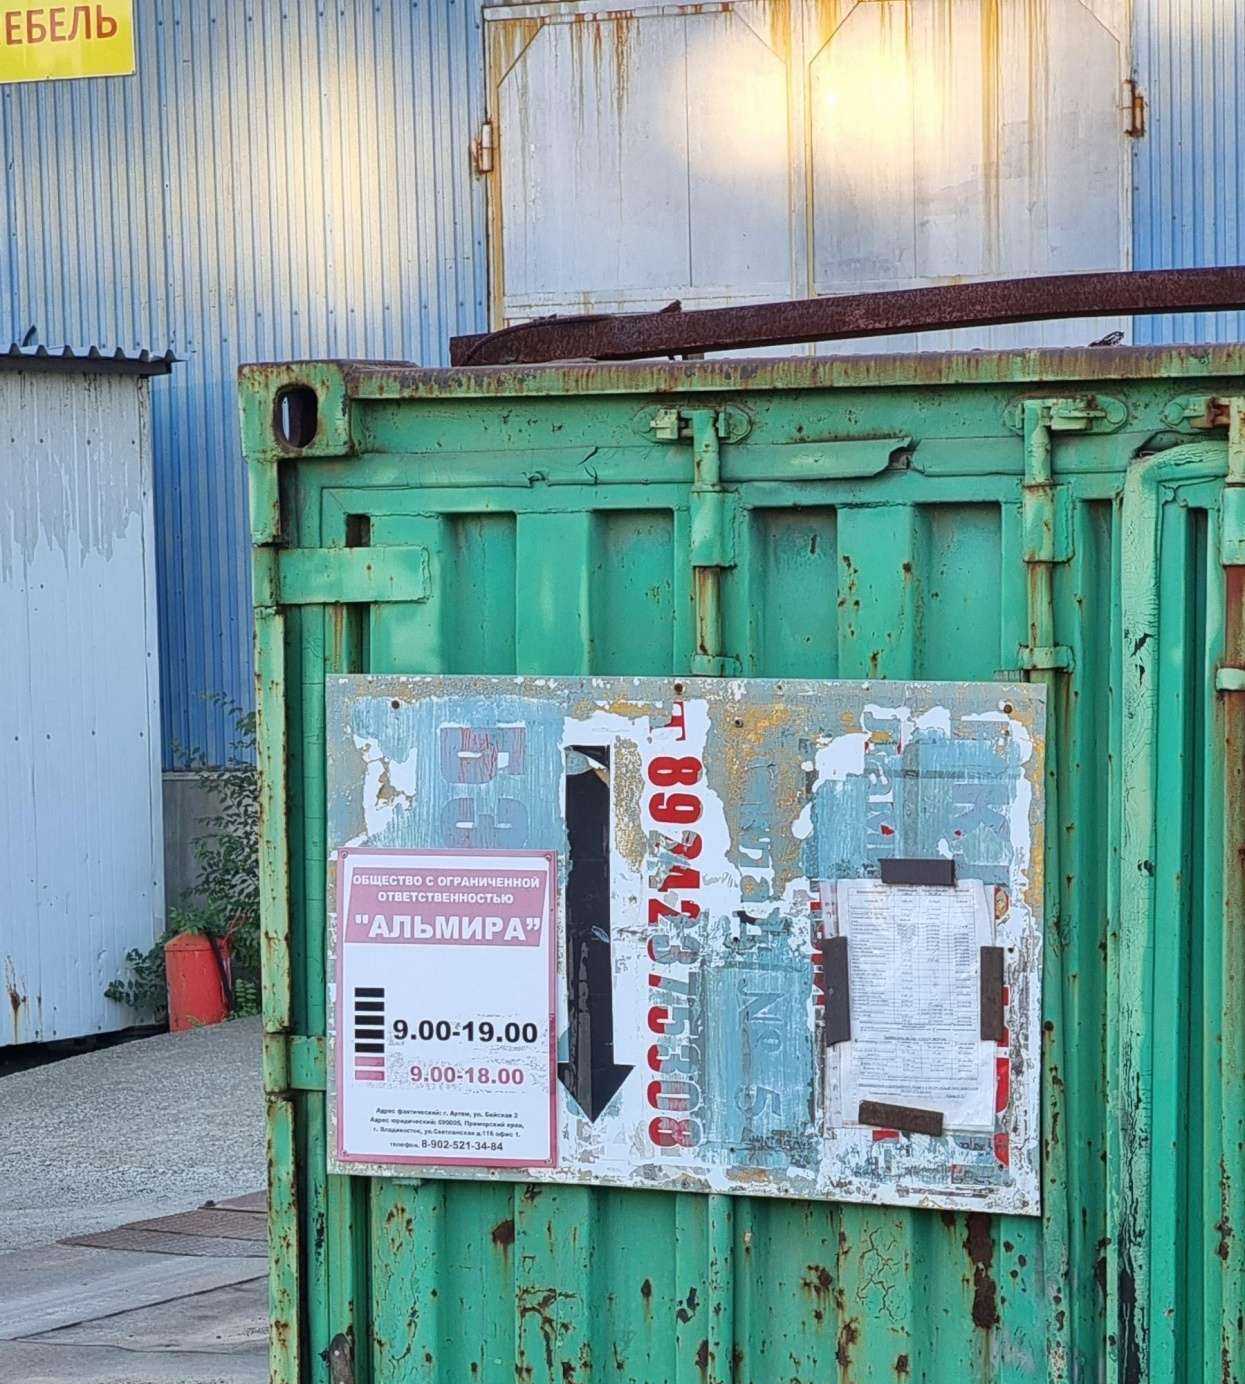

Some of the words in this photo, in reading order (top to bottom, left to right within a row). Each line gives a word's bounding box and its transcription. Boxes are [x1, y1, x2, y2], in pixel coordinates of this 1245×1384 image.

[0, 5, 118, 45] ЕБЕЛЬ
[353, 874, 422, 887] ОБЩЕСТВО
[425, 876, 434, 886] С
[437, 876, 540, 888] ОГРАНИЧЕННОЙ
[377, 891, 514, 904] ОТВЕТСТВЕННОСТЬЮ
[392, 1019, 538, 1043] 9.00-19.00
[410, 1065, 525, 1085] 9.00-18.00
[421, 1139, 503, 1151] 8-902-521-34-84
